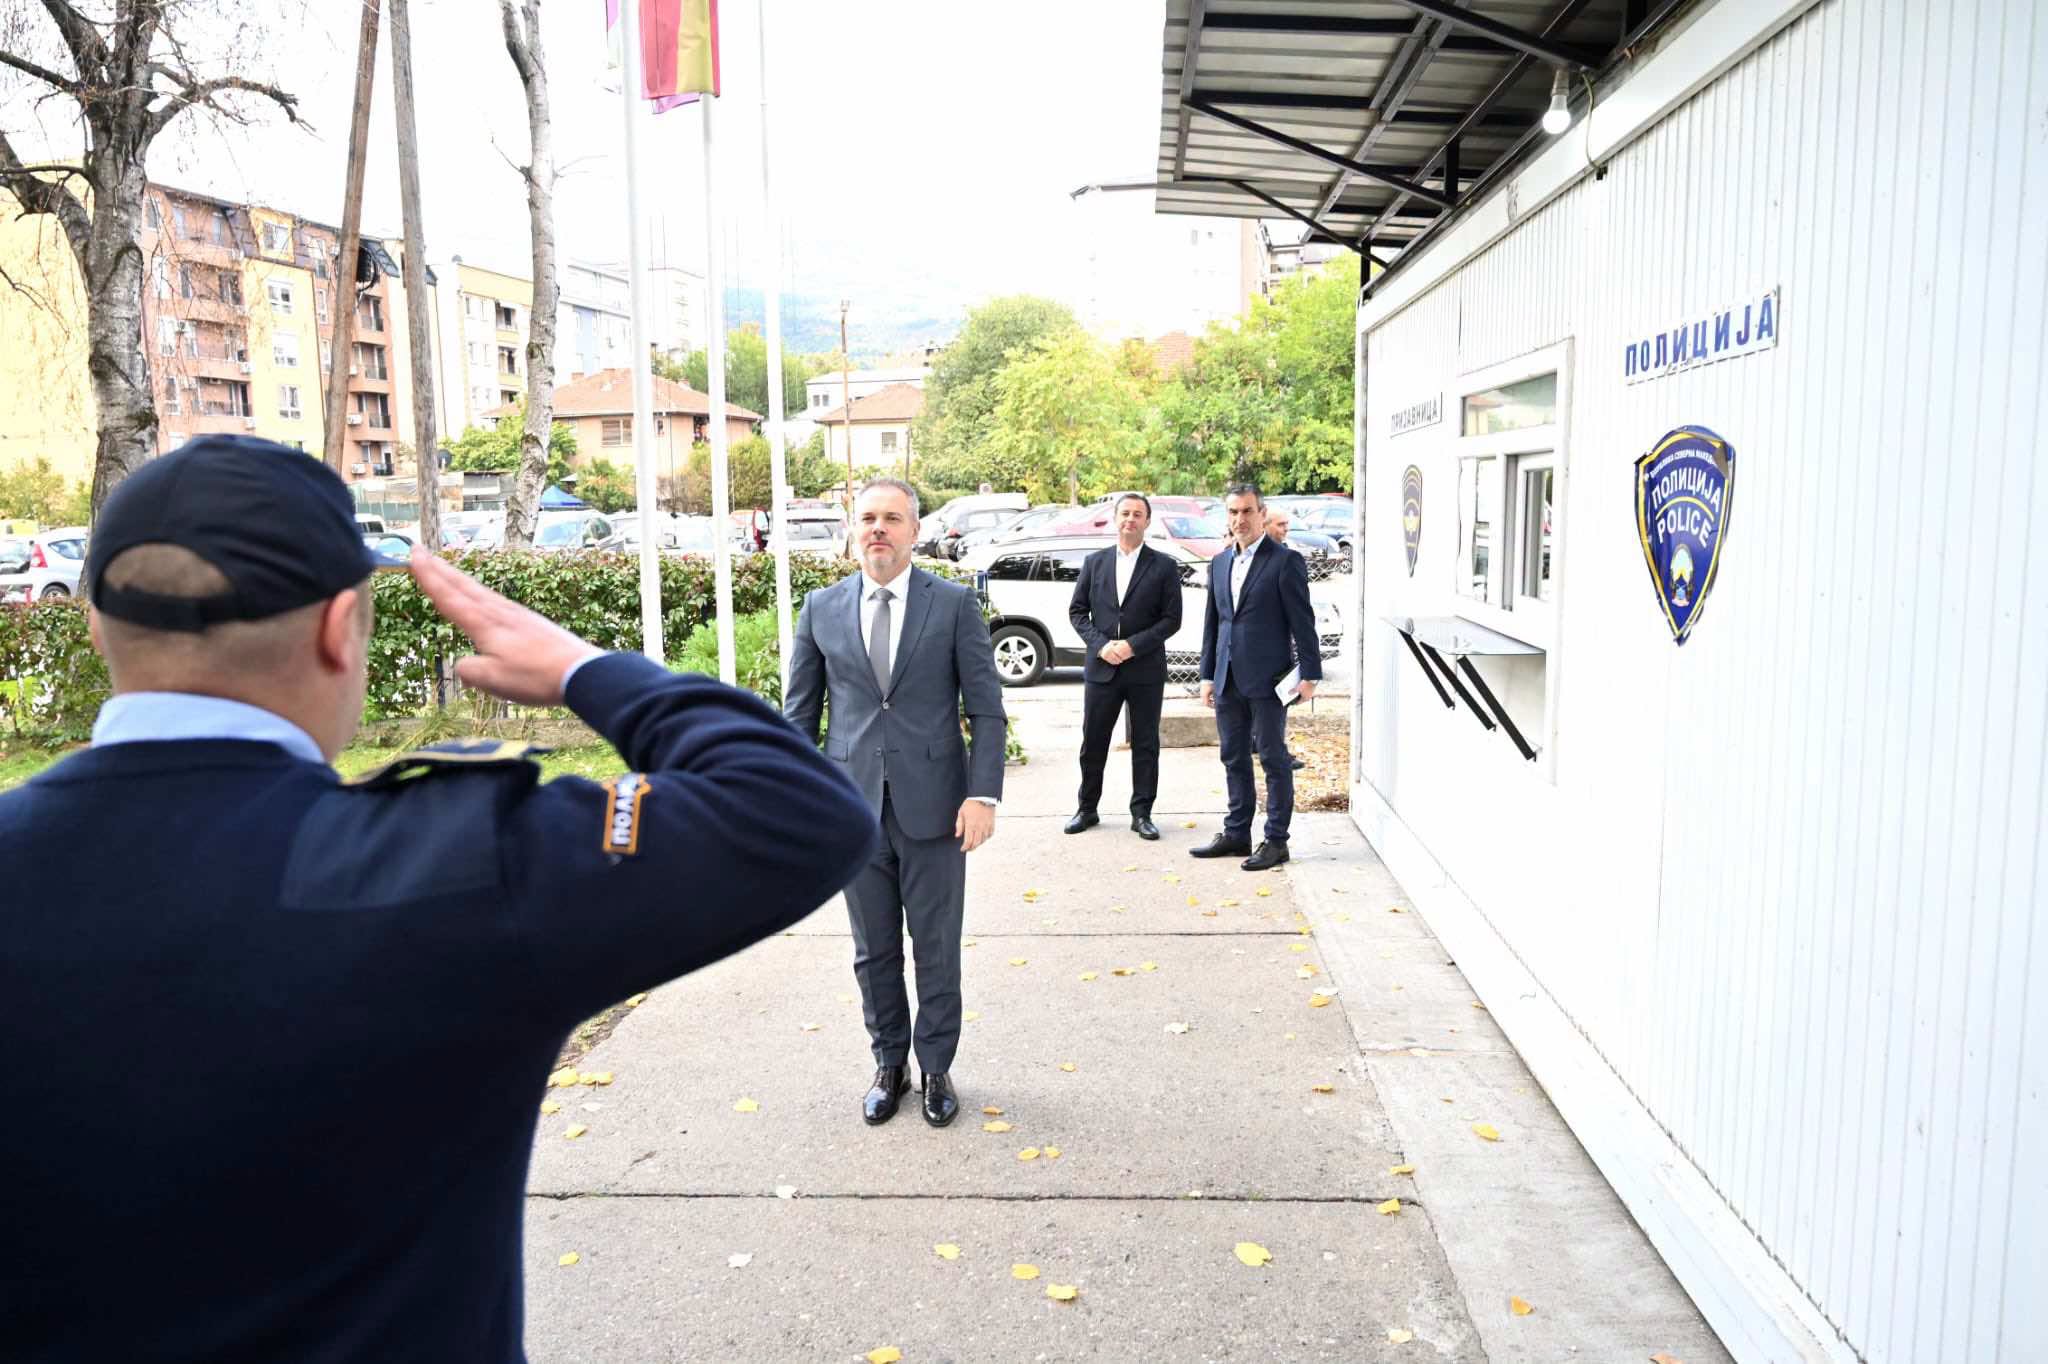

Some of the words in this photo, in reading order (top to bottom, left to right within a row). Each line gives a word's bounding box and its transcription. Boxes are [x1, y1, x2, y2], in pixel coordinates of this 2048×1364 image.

[1625, 298, 1773, 377] ПОЛИЦИЈА
[1652, 467, 1721, 512] ПОЛИЦИЈА
[1657, 507, 1712, 548] POLICE
